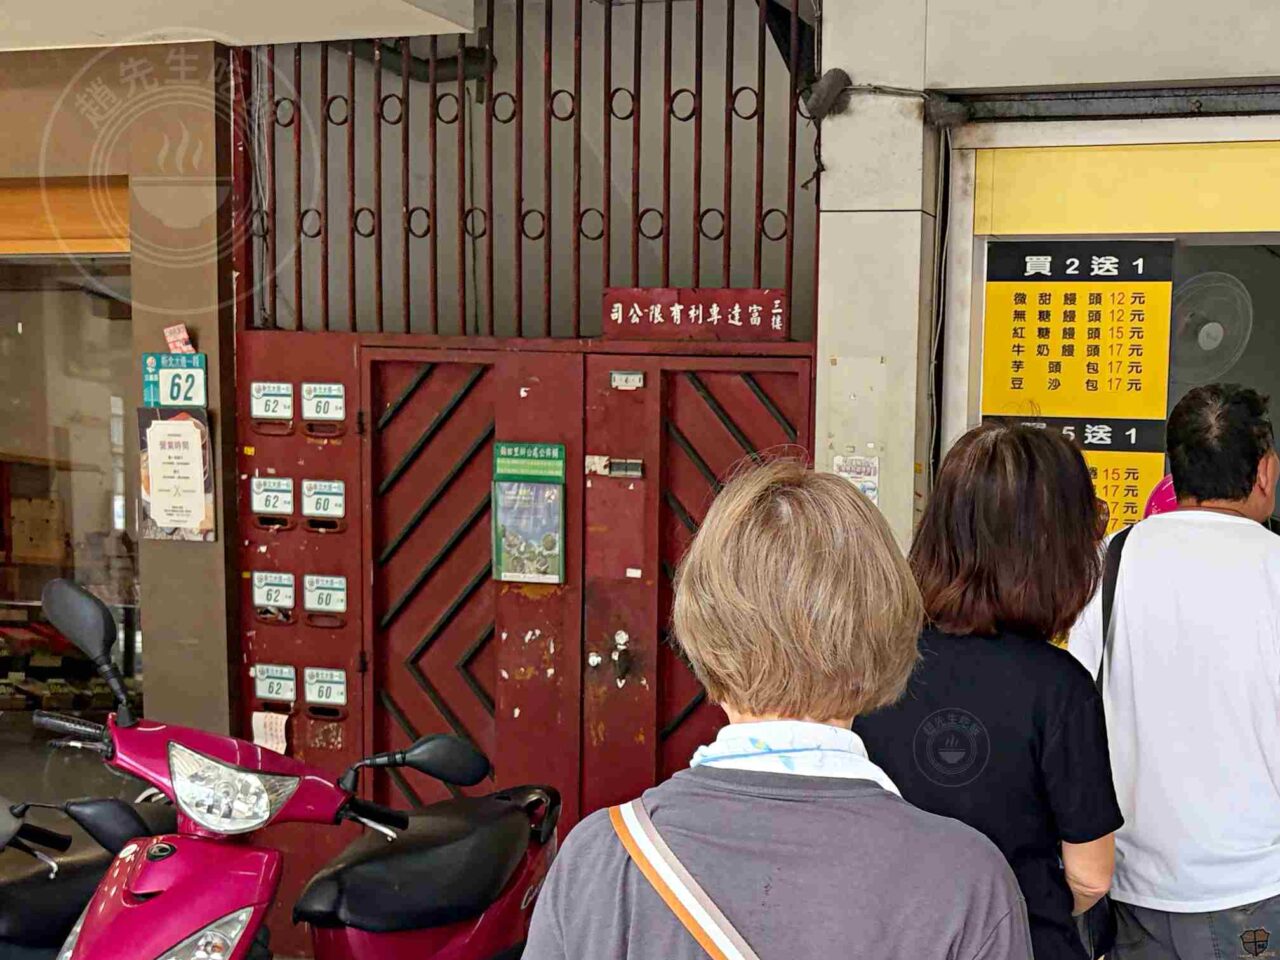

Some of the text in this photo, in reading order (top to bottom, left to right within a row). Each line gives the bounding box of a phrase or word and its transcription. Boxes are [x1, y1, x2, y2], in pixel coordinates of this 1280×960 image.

[1024, 256, 1144, 276] 買2送1
[170, 373, 195, 401] 62
[264, 400, 279, 413] 62
[315, 401, 330, 414] 60
[1021, 422, 1138, 445] 5送1
[264, 495, 279, 508] 62
[315, 498, 329, 511] 60
[266, 589, 281, 602] 62
[317, 592, 332, 606] 60
[268, 682, 282, 695] 62
[317, 685, 332, 699] 60
